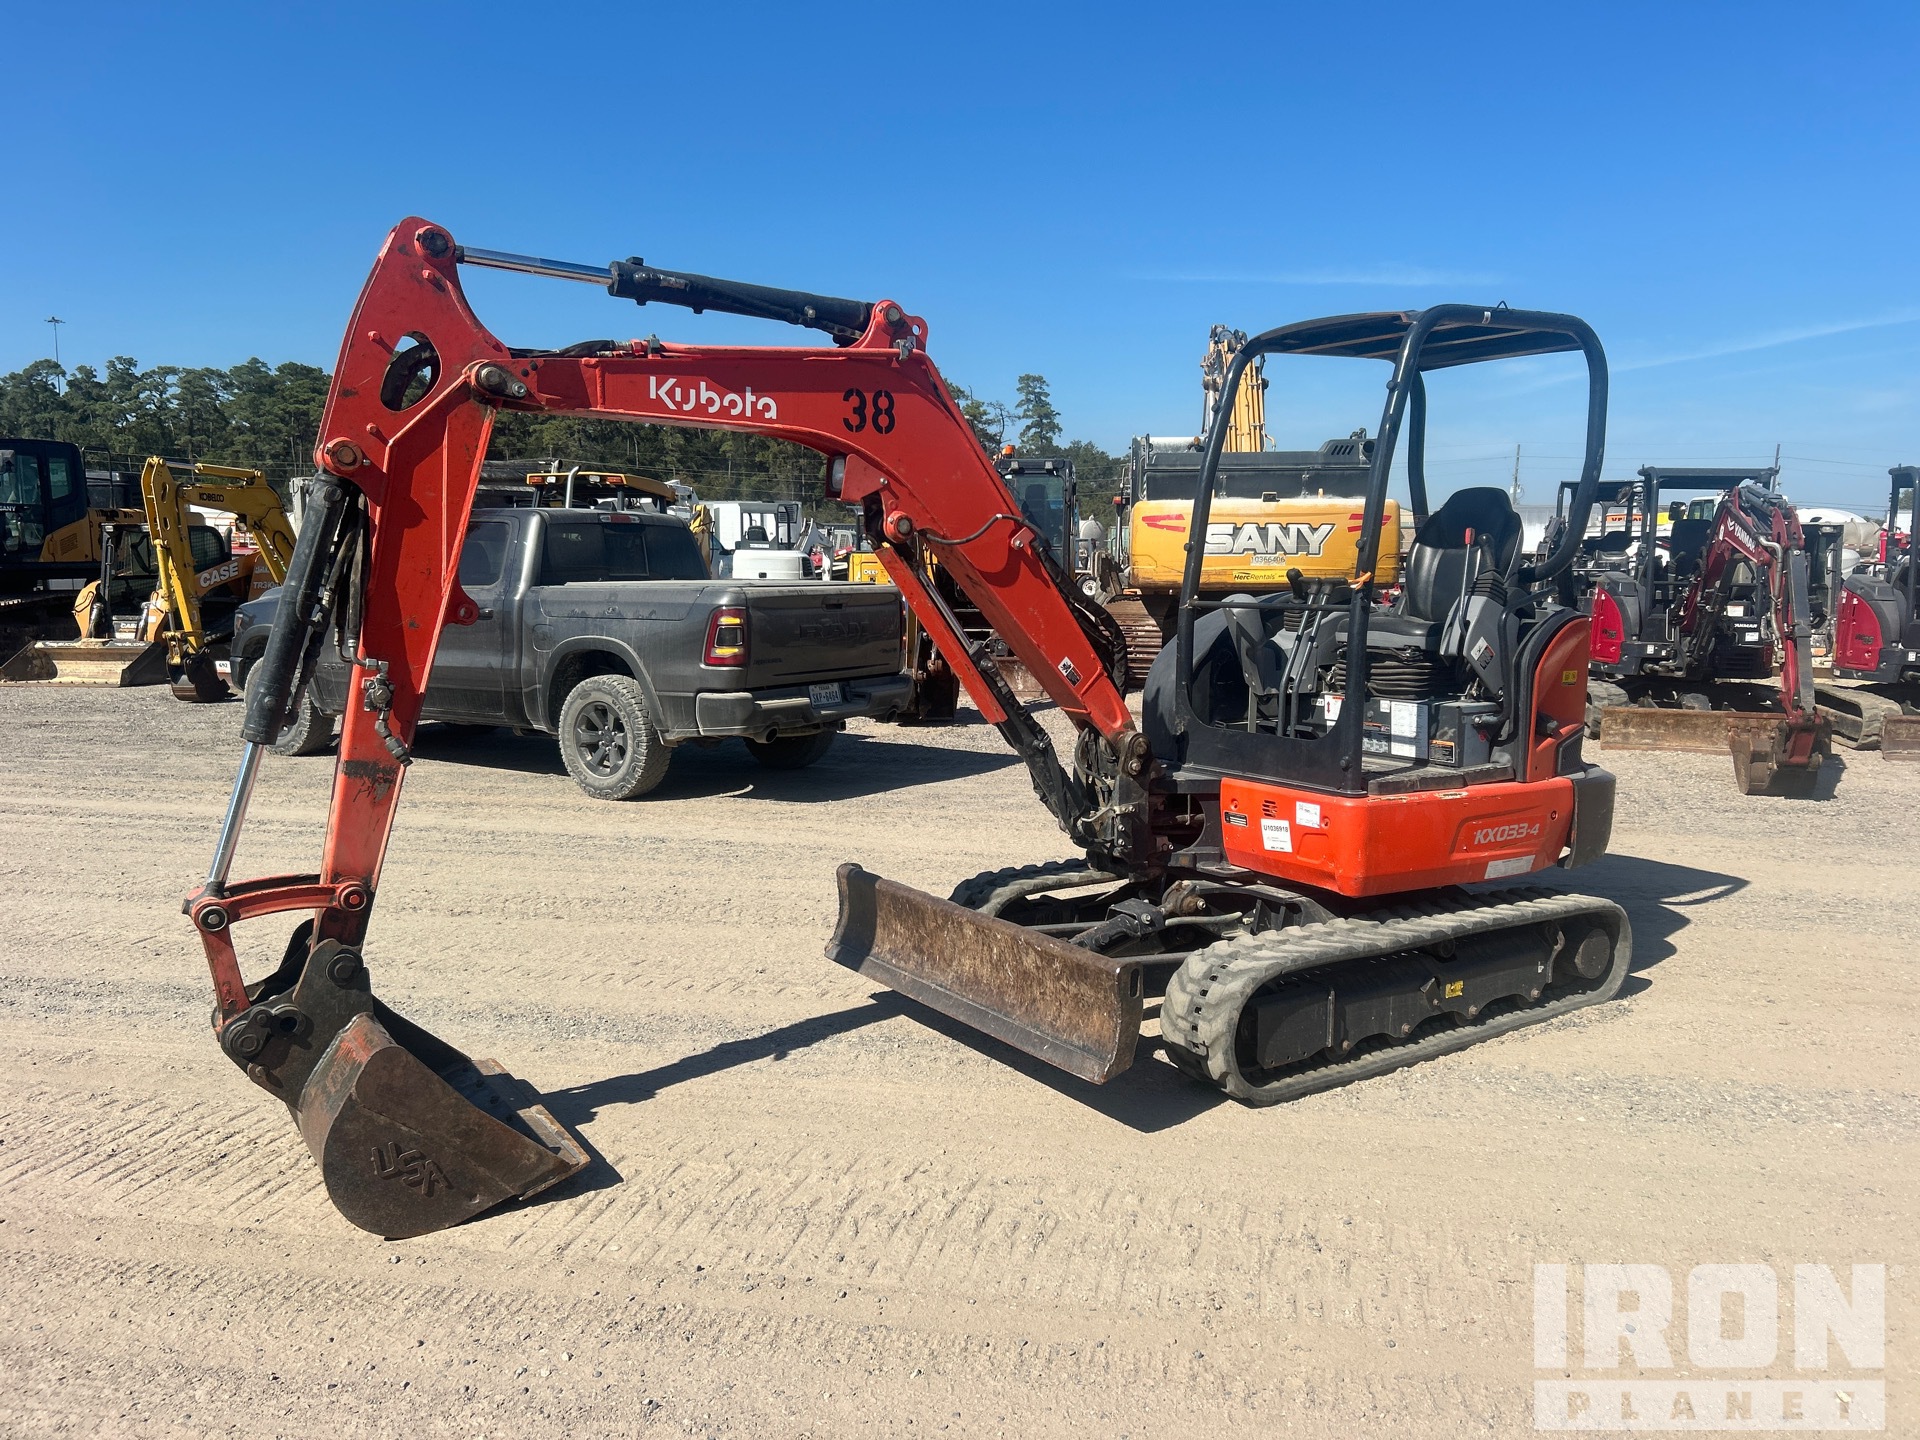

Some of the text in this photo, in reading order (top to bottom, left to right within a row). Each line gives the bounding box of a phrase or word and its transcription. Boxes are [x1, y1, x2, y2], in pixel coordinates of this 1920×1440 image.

[649, 375, 778, 420] Kubota
[842, 388, 896, 434] 38
[199, 492, 224, 503] KOBELCO
[1202, 523, 1336, 556] SANY
[200, 562, 239, 587] CASE
[1474, 822, 1540, 845] KX033-4
